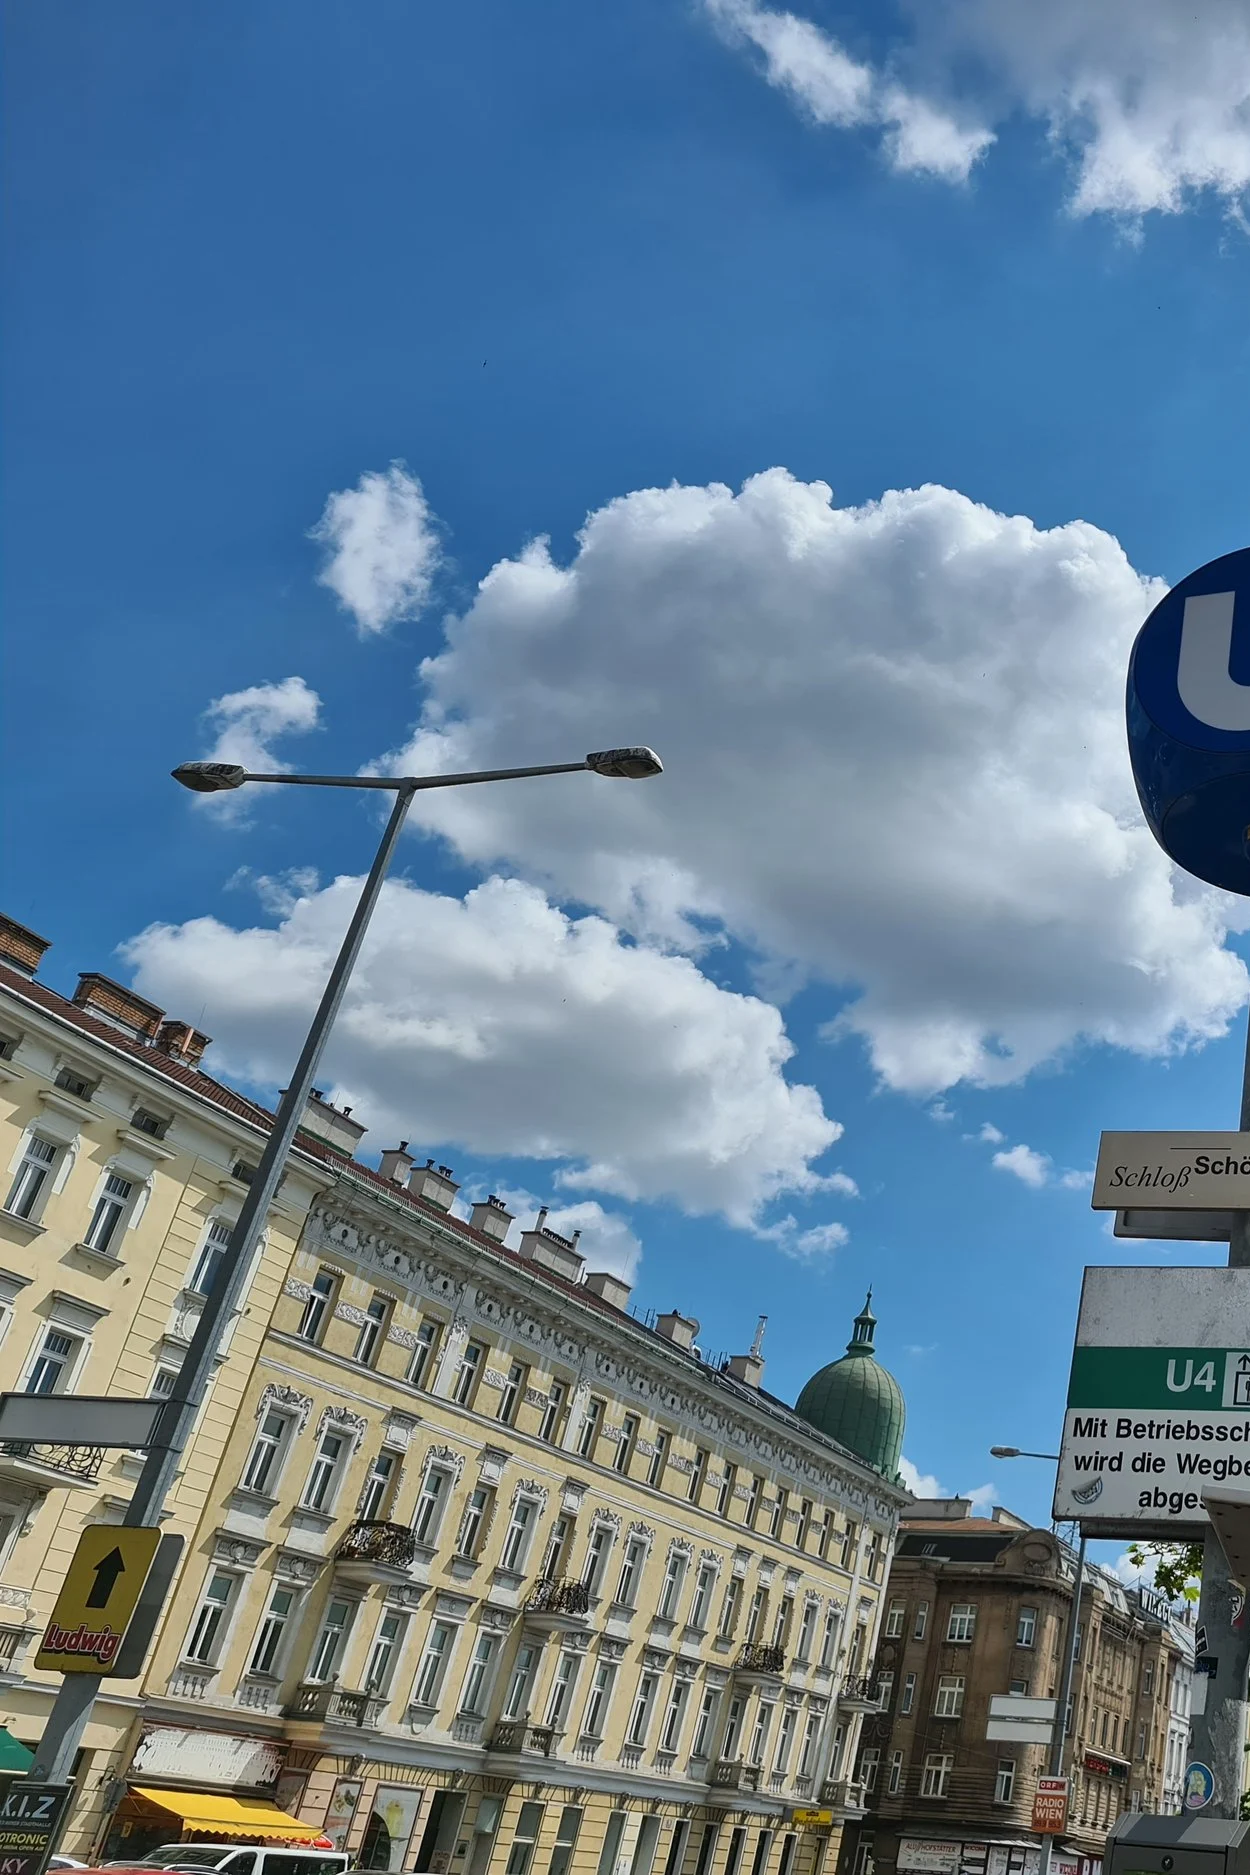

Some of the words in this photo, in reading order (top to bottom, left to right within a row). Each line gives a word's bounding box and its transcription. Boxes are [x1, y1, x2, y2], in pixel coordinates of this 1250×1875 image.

[1110, 1165, 1191, 1193] Schloß
[1166, 1358, 1216, 1393] U4
[1072, 1417, 1108, 1439] Mit
[1074, 1451, 1124, 1473] wird
[1131, 1451, 1166, 1474] die
[42, 1623, 121, 1664] Ludwig
[1040, 1781, 1057, 1789] ORF
[0, 1794, 56, 1819] K.I.Z
[1035, 1807, 1063, 1820] WIEN
[1036, 1797, 1065, 1809] RADIO
